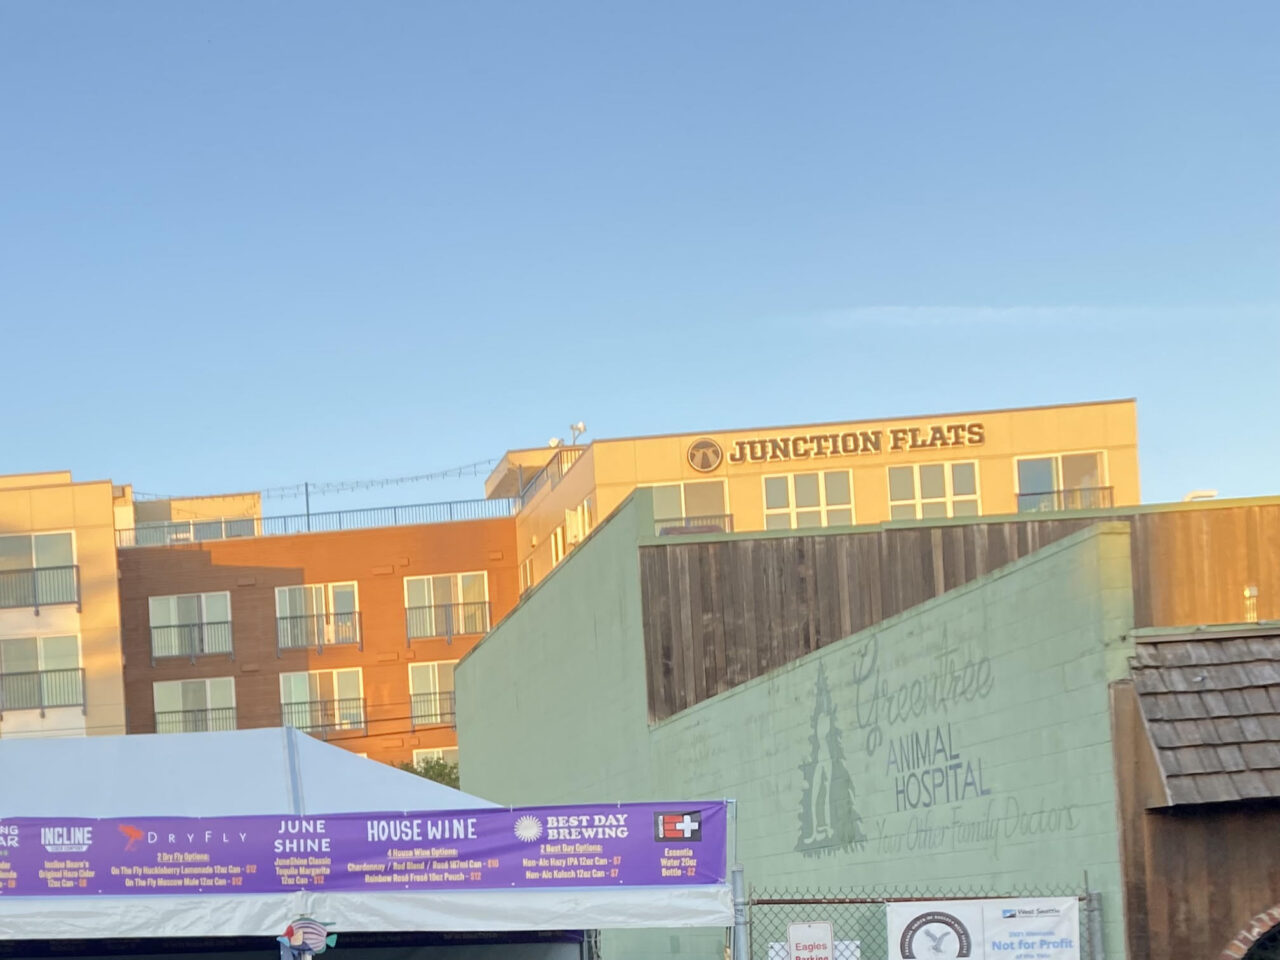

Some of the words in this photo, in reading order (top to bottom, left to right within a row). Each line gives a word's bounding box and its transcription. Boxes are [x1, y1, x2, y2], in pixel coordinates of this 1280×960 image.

[729, 431, 882, 464] JUNCTION
[888, 423, 985, 450] FLATS
[886, 722, 960, 776] ANIMAL
[895, 758, 992, 812] HOSPITAL
[278, 820, 326, 834] JUNE
[546, 816, 590, 828] BEST
[594, 814, 629, 826] DAY
[41, 827, 93, 844] INCLINE
[367, 819, 422, 842] HOUSE
[427, 818, 478, 840] WINE
[547, 827, 630, 840] BREWING
[907, 808, 947, 851] Other
[947, 799, 1001, 863] Family
[1005, 796, 1080, 839] Doctors
[274, 838, 331, 852] SHINE
[393, 848, 414, 857] House
[414, 848, 430, 856] Wine
[348, 862, 386, 872] Chardonnay
[469, 860, 482, 868] Can
[567, 857, 578, 866] IPA
[579, 857, 594, 866] 12oz
[594, 856, 608, 865] Can
[660, 858, 680, 866] Water
[121, 866, 132, 874] The
[133, 866, 142, 876] Fly
[576, 870, 591, 878] 12oz
[592, 868, 605, 878] Can
[134, 878, 146, 886] The
[147, 878, 157, 888] Fly
[796, 942, 827, 952] Eagles
[992, 940, 1015, 950] Not
[1018, 939, 1036, 950] for
[1039, 938, 1074, 949] Profit
